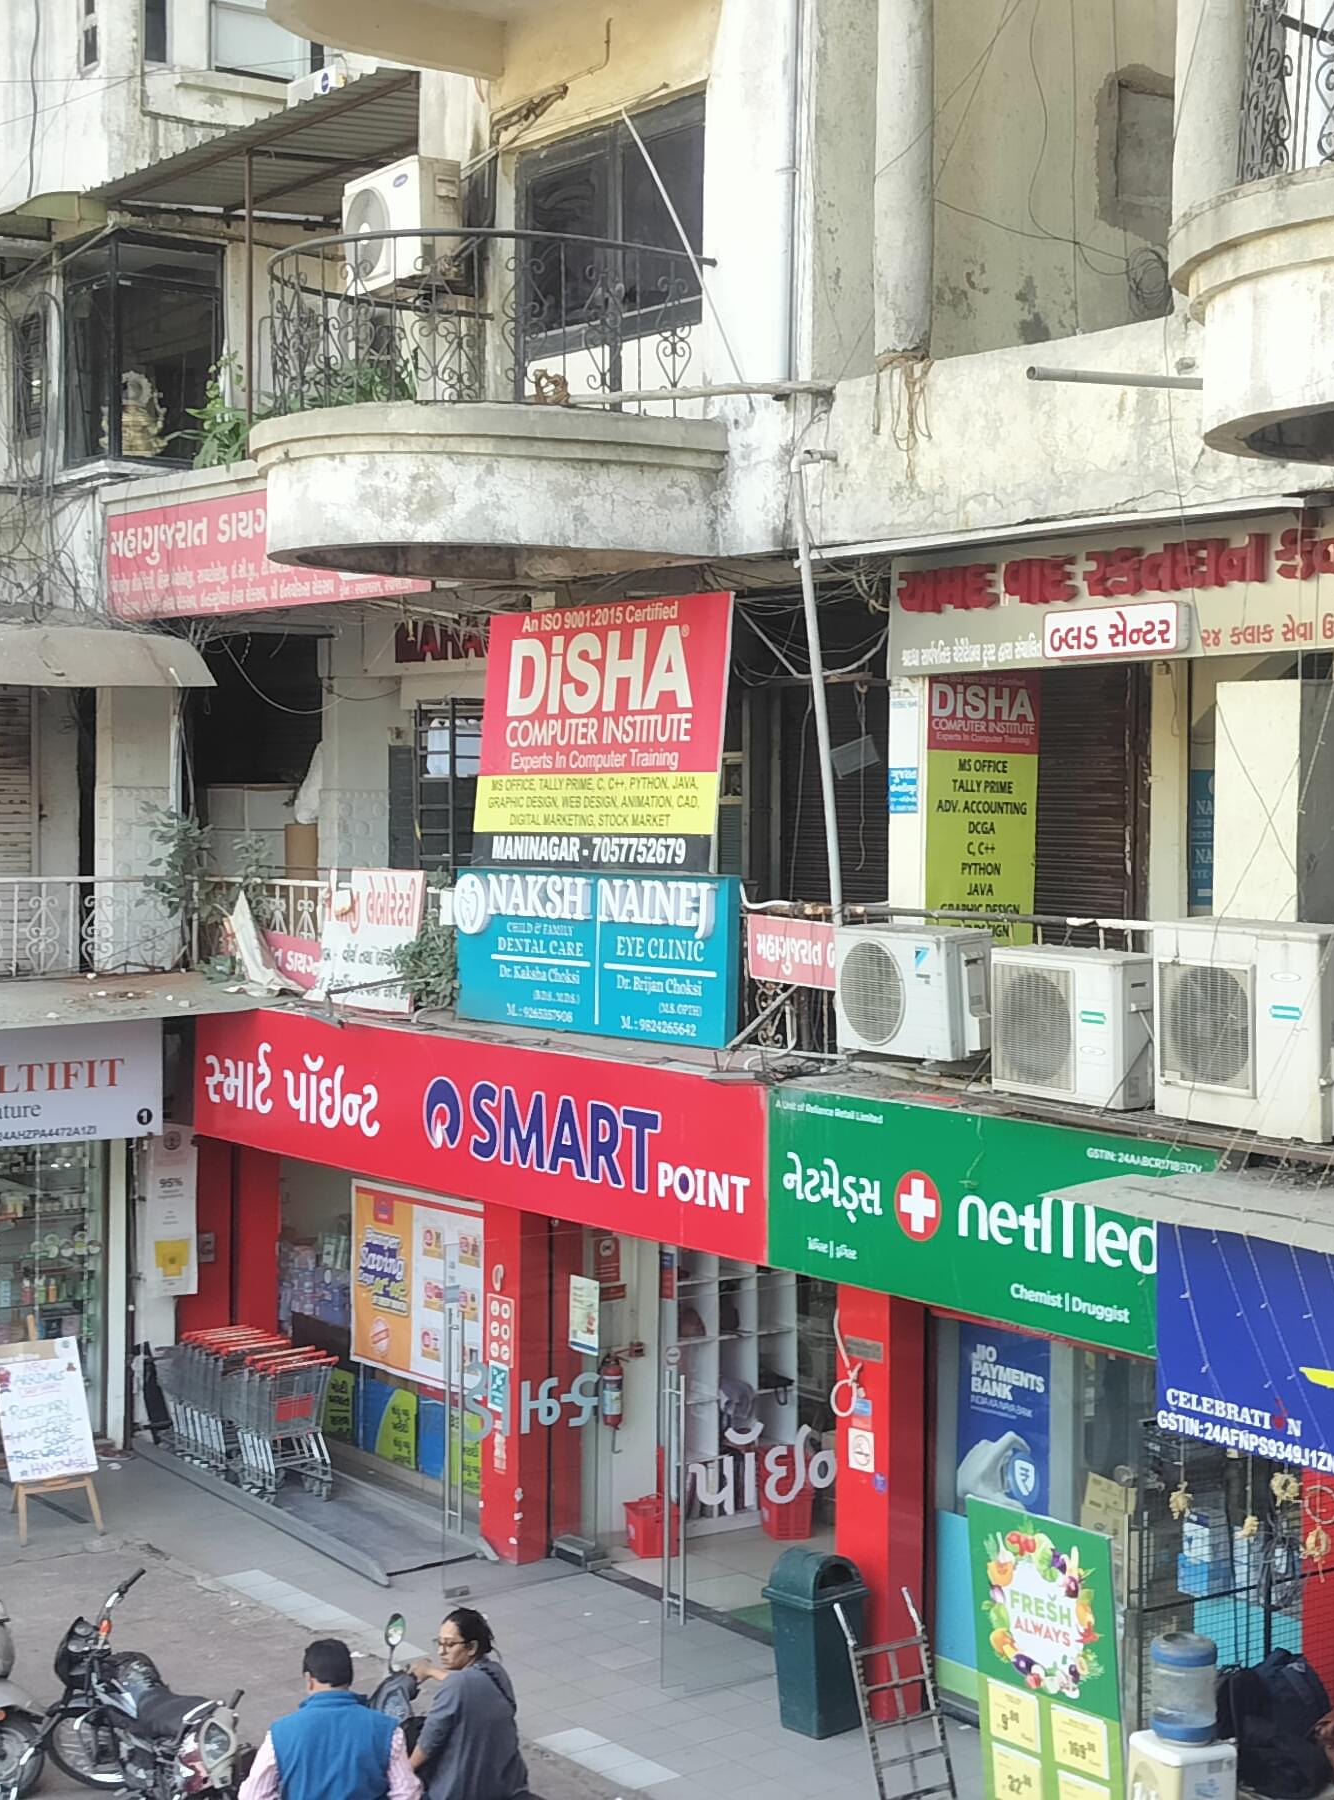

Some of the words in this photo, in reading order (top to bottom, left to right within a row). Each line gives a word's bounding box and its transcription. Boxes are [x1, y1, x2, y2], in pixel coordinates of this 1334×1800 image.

[521, 615, 539, 634] An
[540, 612, 561, 632] ISO
[563, 605, 623, 630] 9001:2015
[624, 600, 679, 622] Certified
[1228, 623, 1274, 646] કલાક
[1281, 613, 1314, 644] સેવા
[1049, 621, 1099, 651] બ્લડ
[1108, 610, 1171, 649] સેન્ટર
[505, 716, 599, 748] COMPUTER
[601, 713, 693, 744] INSTITUTE
[931, 717, 987, 733] COMPUTER
[988, 722, 1035, 735] INSTITUTE
[510, 751, 553, 773] Experts
[555, 750, 567, 769] In
[569, 749, 628, 773] Computer
[629, 747, 679, 772] Training
[958, 758, 973, 772] MS
[973, 759, 1008, 774] OFFICE
[539, 777, 563, 791] TALLY
[952, 778, 983, 793] TALLY
[984, 780, 1013, 795] PRIME
[487, 795, 525, 809] GRAPHIC
[561, 795, 582, 809] WEB
[935, 799, 961, 814] ADV.
[962, 800, 1028, 816] ACCOUNTING
[509, 813, 542, 827] DIGITAL
[598, 813, 631, 828] STOCK
[631, 813, 671, 827] MARKET
[968, 821, 996, 836] DCGA
[491, 834, 580, 863] MANINAGAR
[591, 837, 686, 865] 7057752679
[966, 841, 976, 857] C,
[977, 841, 996, 856] C++
[961, 862, 1001, 877] PYTHON
[486, 873, 593, 921] NAKSH
[966, 883, 994, 897] JAVA
[597, 878, 719, 940] NAINEJ
[496, 936, 546, 955] DENTAL
[549, 940, 585, 958] CARE
[616, 935, 646, 958] EYE
[647, 938, 705, 963] CLINIC
[755, 932, 823, 976] મહાગુજરાત
[499, 964, 512, 979] Dr.
[548, 967, 581, 986] Choksi
[616, 973, 632, 991] Dr.
[633, 975, 664, 996] Brijan
[665, 977, 703, 998] Choksi
[204, 1041, 273, 1115] સ્માર્ટ
[781, 1100, 798, 1111] Unit
[805, 1104, 834, 1117] Reliance
[855, 1110, 884, 1125] Limited
[468, 1081, 662, 1193] SMART
[656, 1161, 752, 1215] POINT
[782, 1150, 884, 1225] નેટમેડ્સ
[1009, 1283, 1063, 1310] Chemist
[1072, 1296, 1131, 1325] Druggist
[971, 1343, 998, 1363] JIO
[970, 1360, 1046, 1394] PAYMENTS
[970, 1376, 1014, 1401] BANK
[1013, 1617, 1072, 1648] ALWAYS
